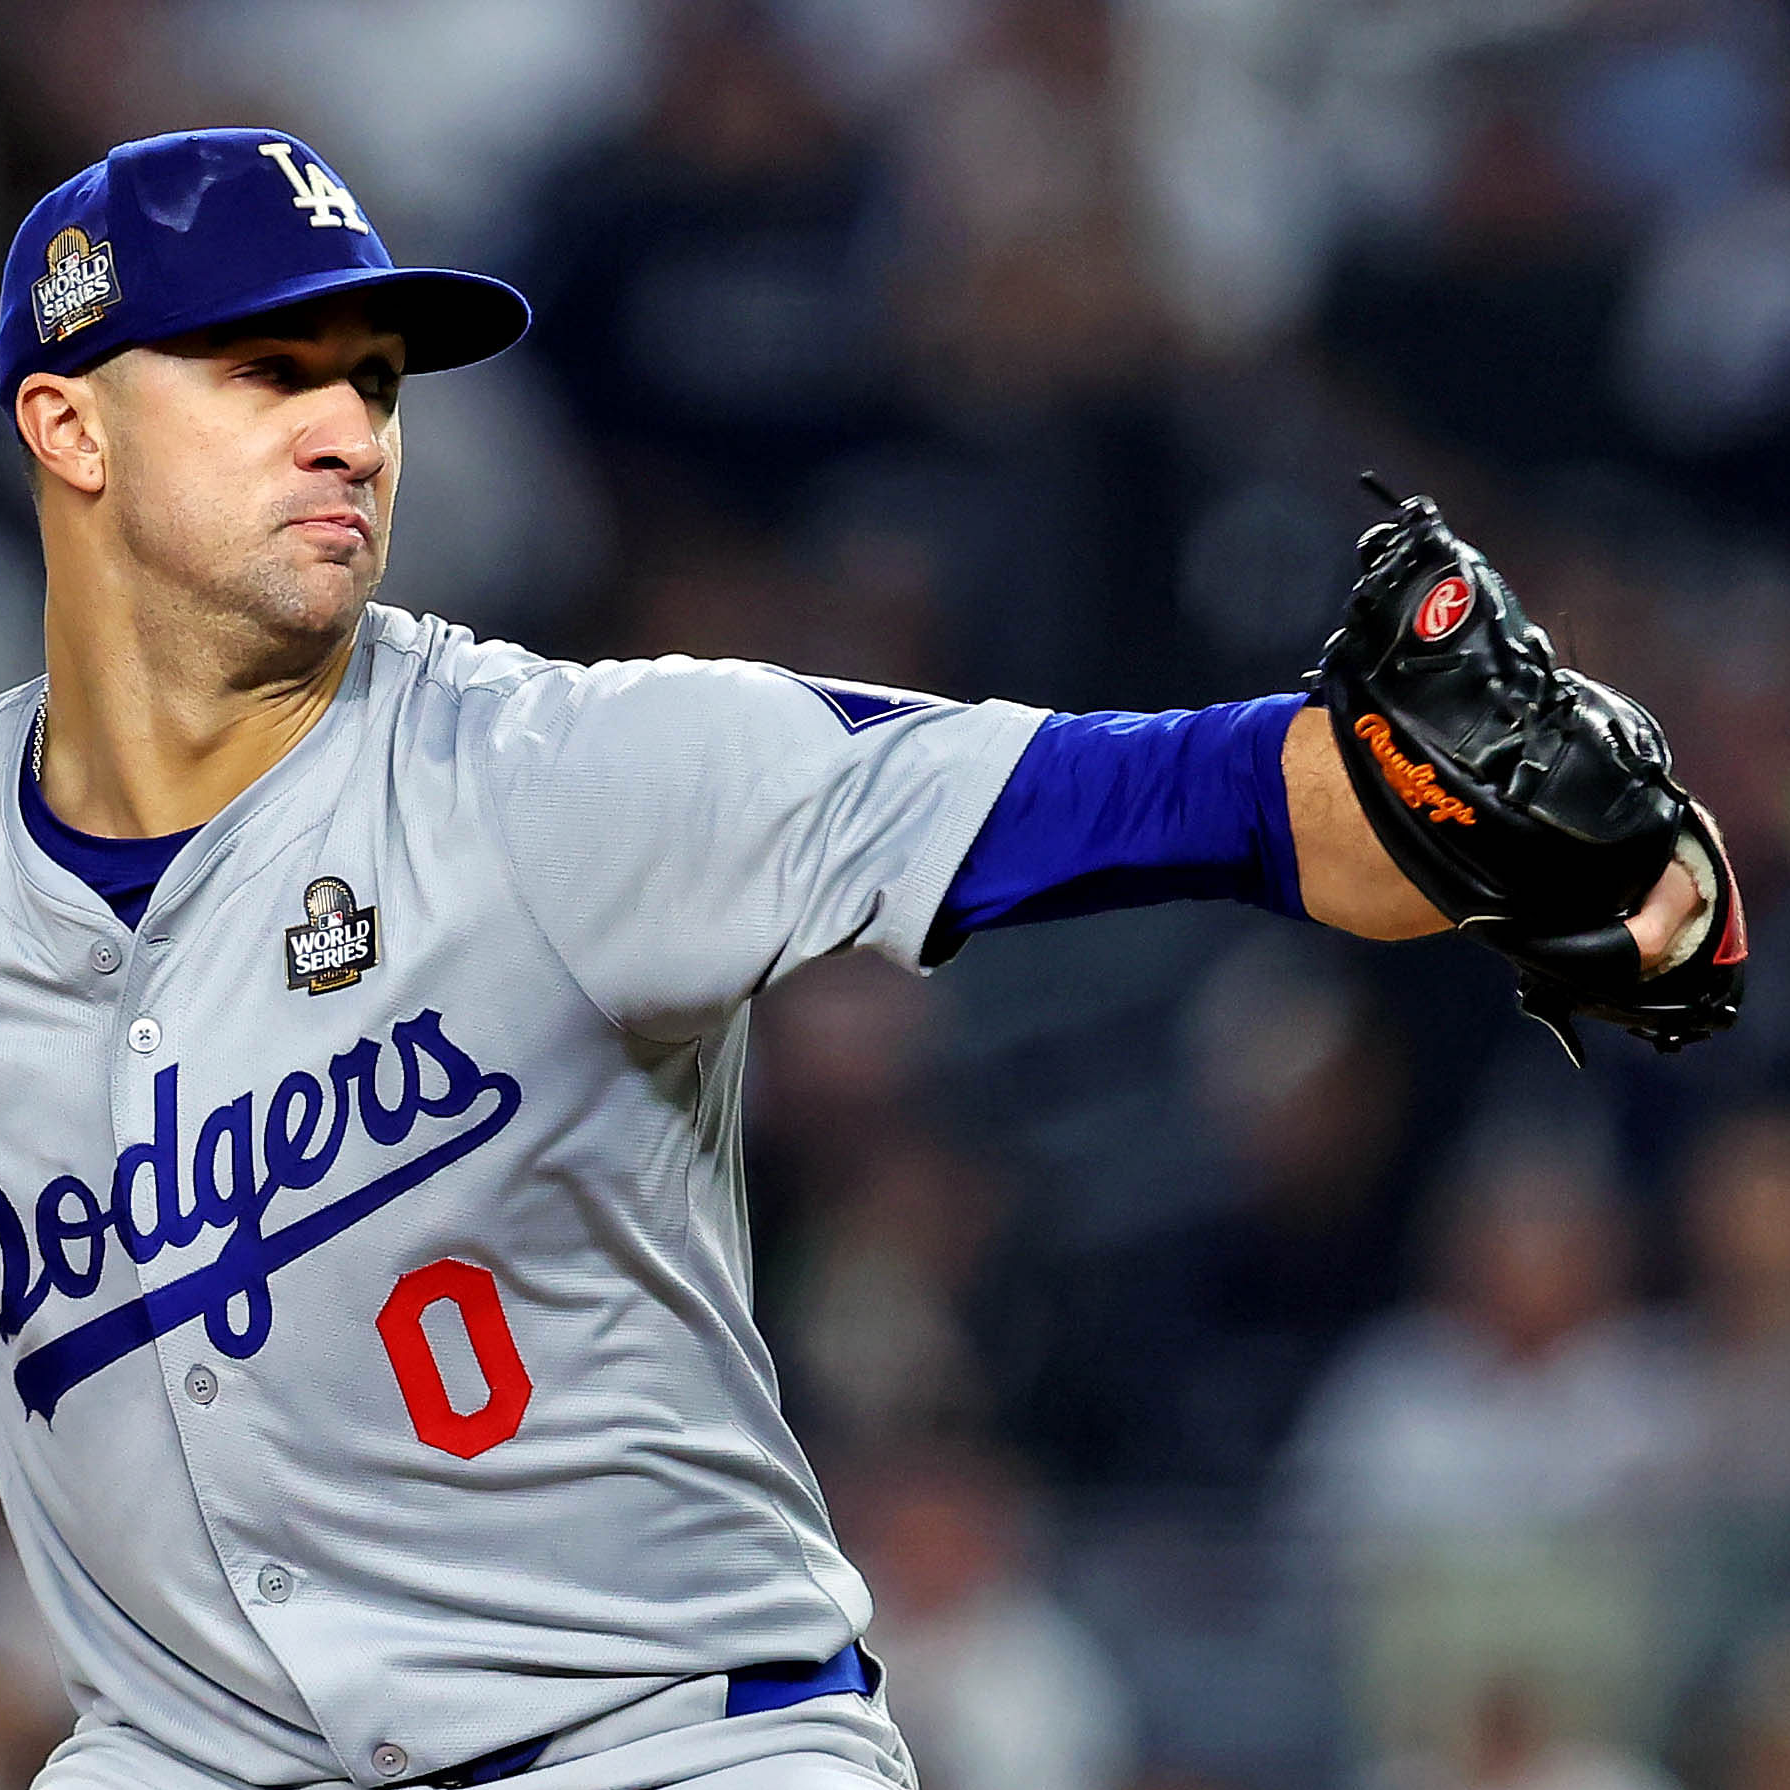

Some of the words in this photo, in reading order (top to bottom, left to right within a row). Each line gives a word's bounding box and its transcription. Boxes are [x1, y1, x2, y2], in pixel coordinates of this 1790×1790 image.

[258, 143, 369, 235] LA
[38, 255, 109, 305] WORLD
[44, 275, 110, 325] SERIES
[290, 920, 370, 956] WORLD
[295, 938, 369, 975] SERIES
[375, 1257, 533, 1460] 0
